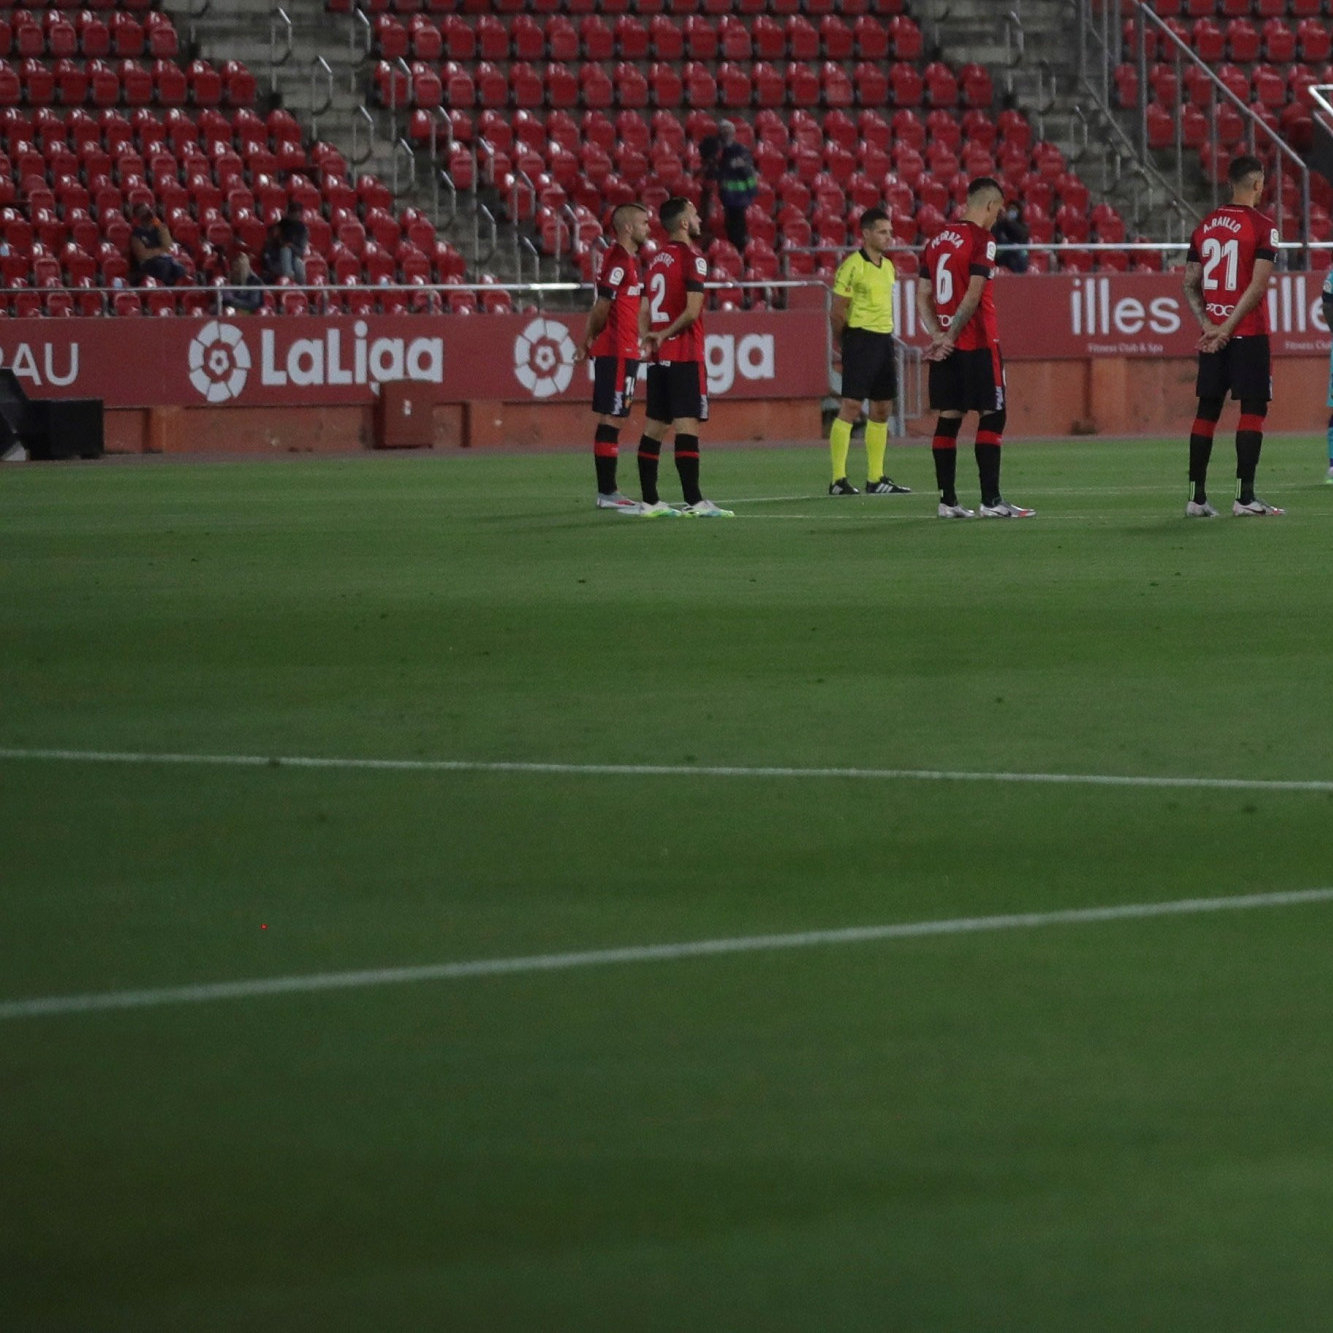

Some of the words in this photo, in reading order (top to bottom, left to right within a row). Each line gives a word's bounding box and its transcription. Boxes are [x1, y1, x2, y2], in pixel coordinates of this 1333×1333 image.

[1203, 217, 1242, 233] A.RAILLO
[936, 253, 953, 305] 6
[1202, 238, 1239, 291] 21
[650, 273, 670, 323] 2
[1071, 278, 1180, 335] illes
[1267, 276, 1332, 333] ille
[261, 319, 443, 396] LaLiga
